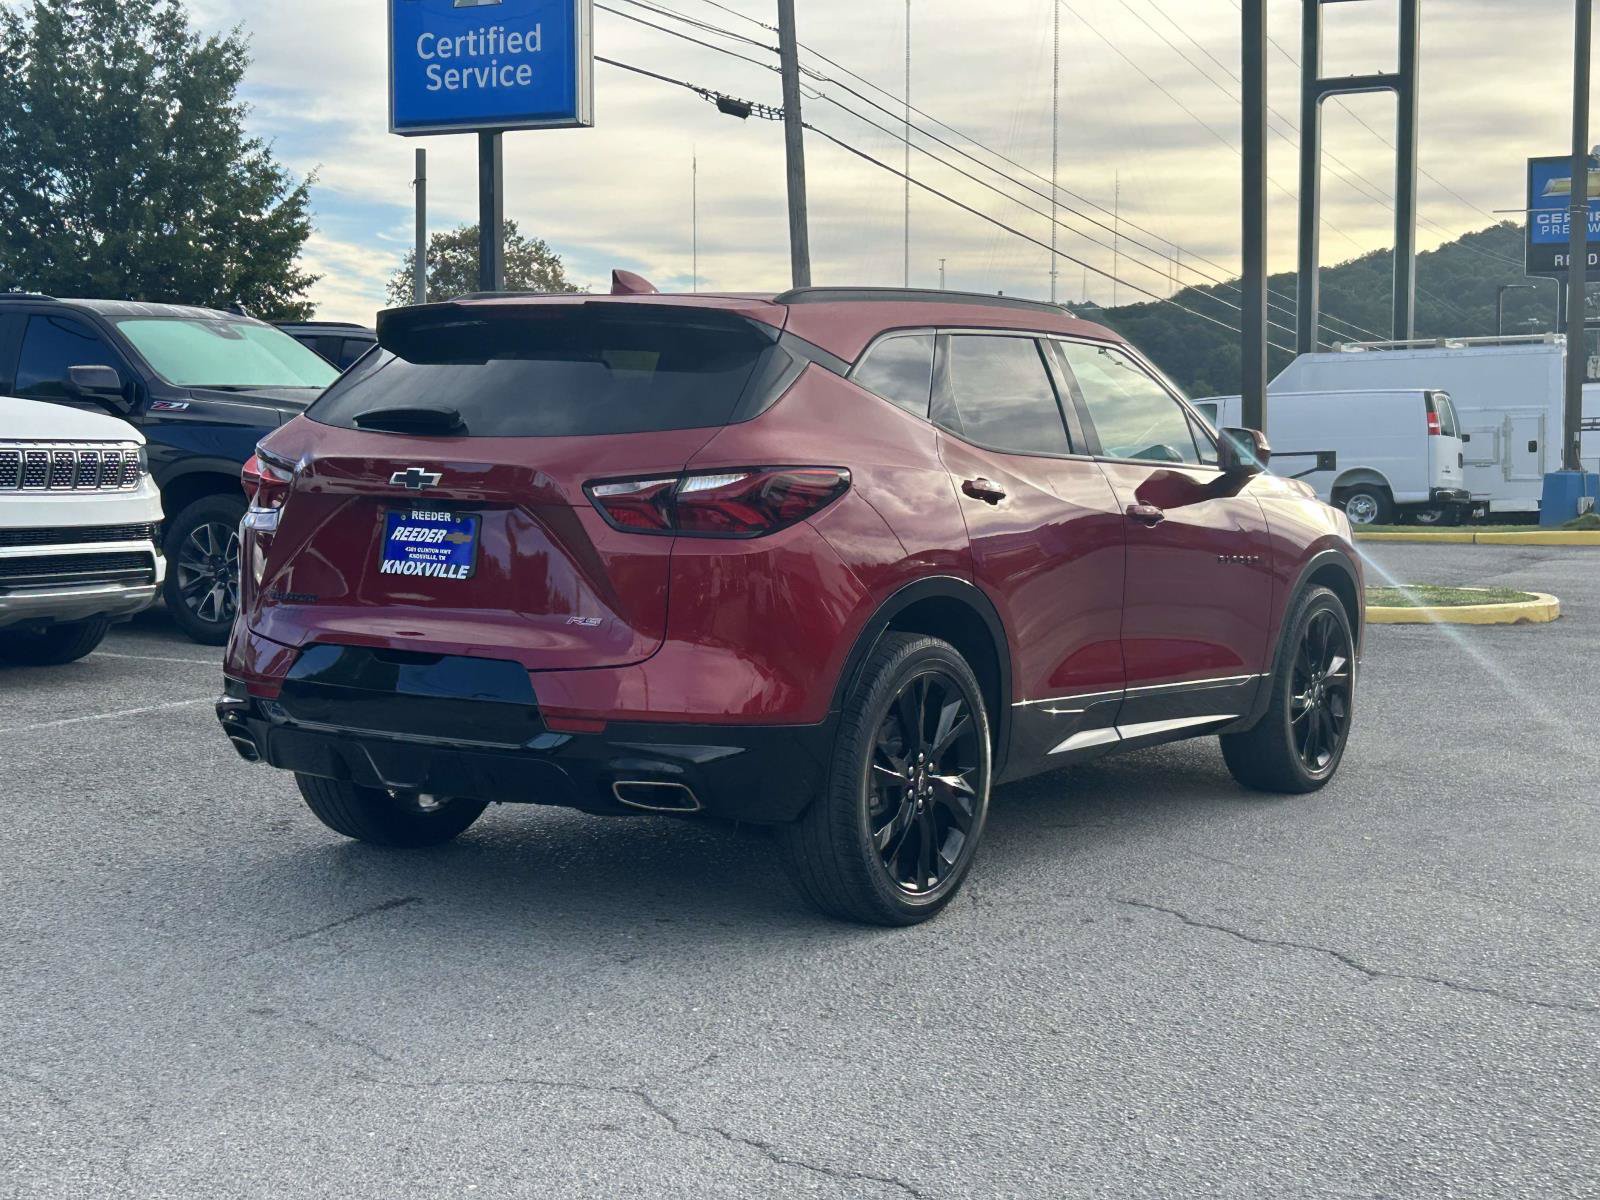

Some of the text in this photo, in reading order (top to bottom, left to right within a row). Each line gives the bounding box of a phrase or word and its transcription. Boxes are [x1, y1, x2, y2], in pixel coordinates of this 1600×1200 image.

[416, 23, 542, 60] Certified
[426, 59, 533, 91] Service
[1537, 211, 1600, 224] CERI
[151, 400, 190, 411] Z71
[411, 510, 452, 522] REEDER
[390, 526, 448, 544] REEDER
[380, 559, 470, 580] KNOXVILLE
